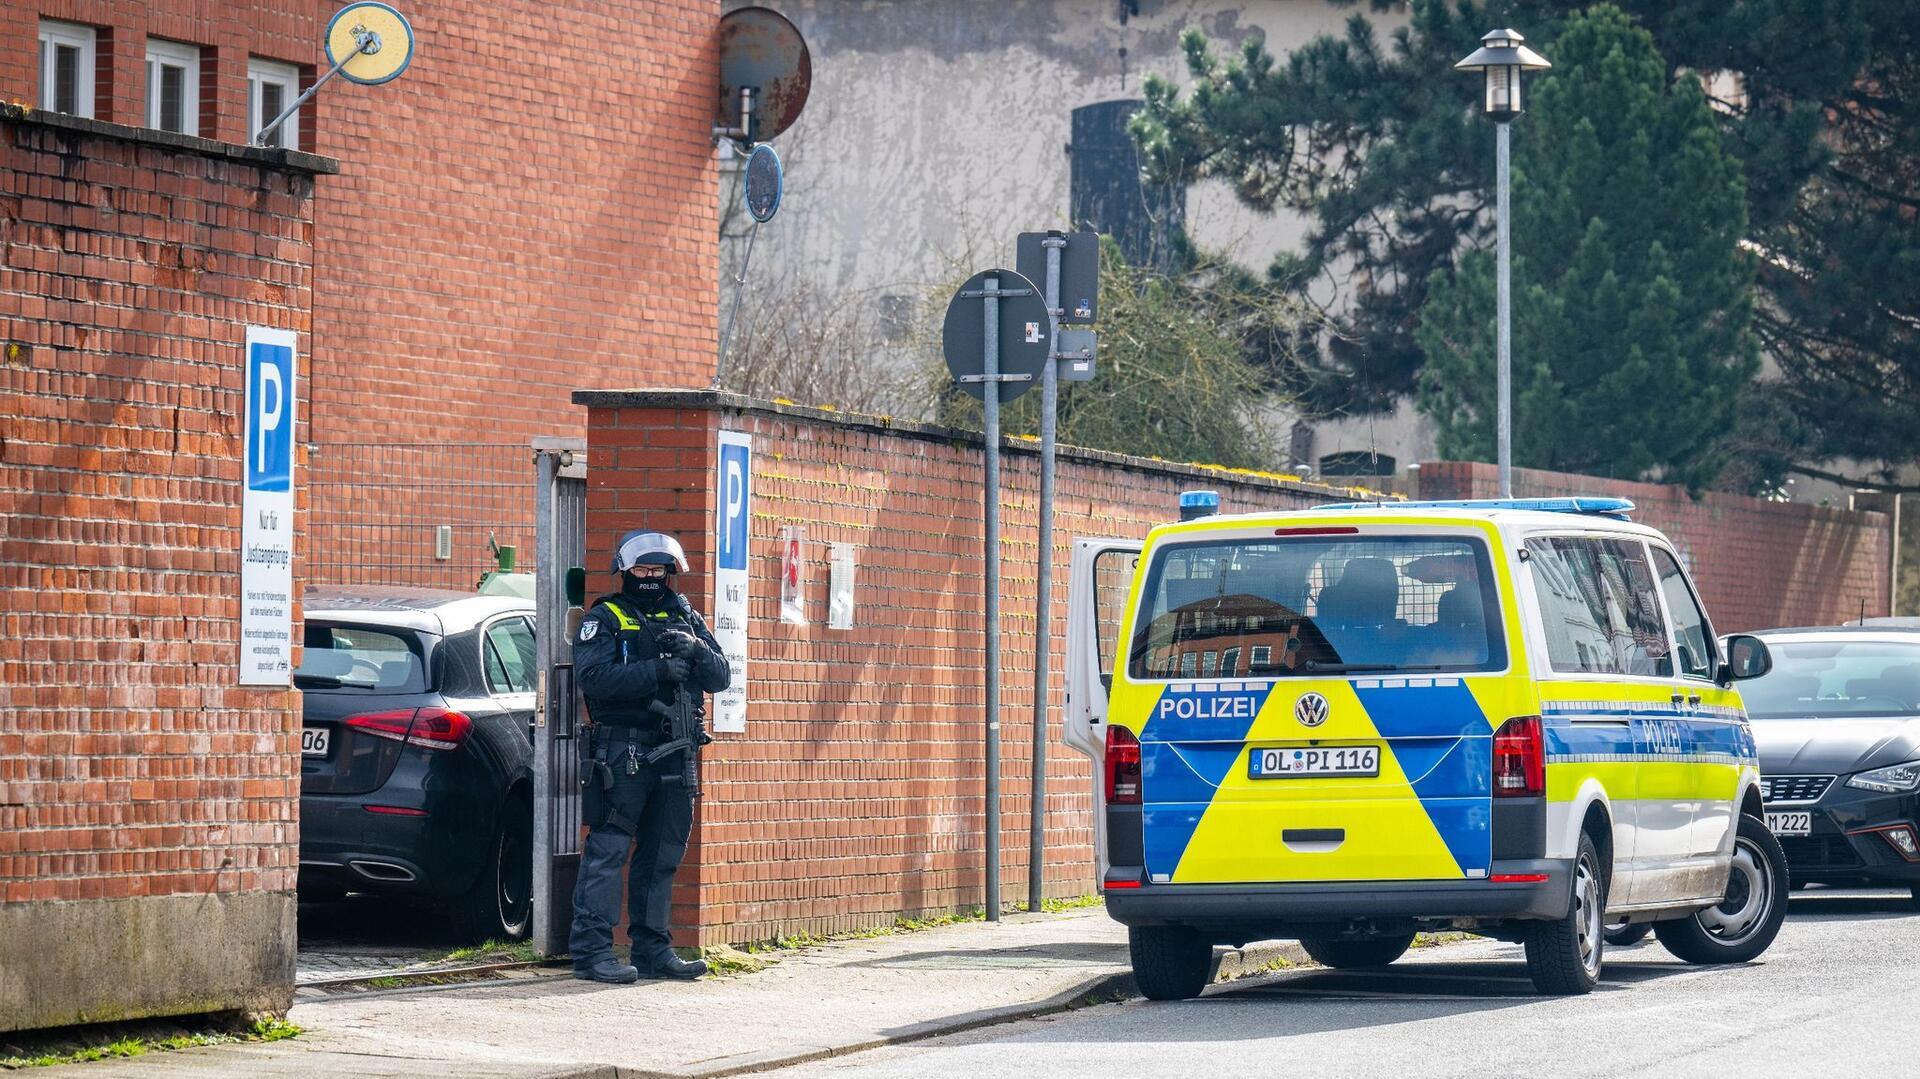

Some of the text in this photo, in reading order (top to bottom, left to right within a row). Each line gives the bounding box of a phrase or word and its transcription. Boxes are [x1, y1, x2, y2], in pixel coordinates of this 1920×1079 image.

[259, 362, 282, 472] P
[725, 460, 742, 553] P
[1160, 697, 1256, 719] POLIZEI
[1642, 719, 1682, 754] POLIZEI
[1264, 752, 1291, 771] OL
[1306, 751, 1330, 770] PI
[1335, 750, 1374, 770] 116
[1781, 814, 1809, 831] 222
